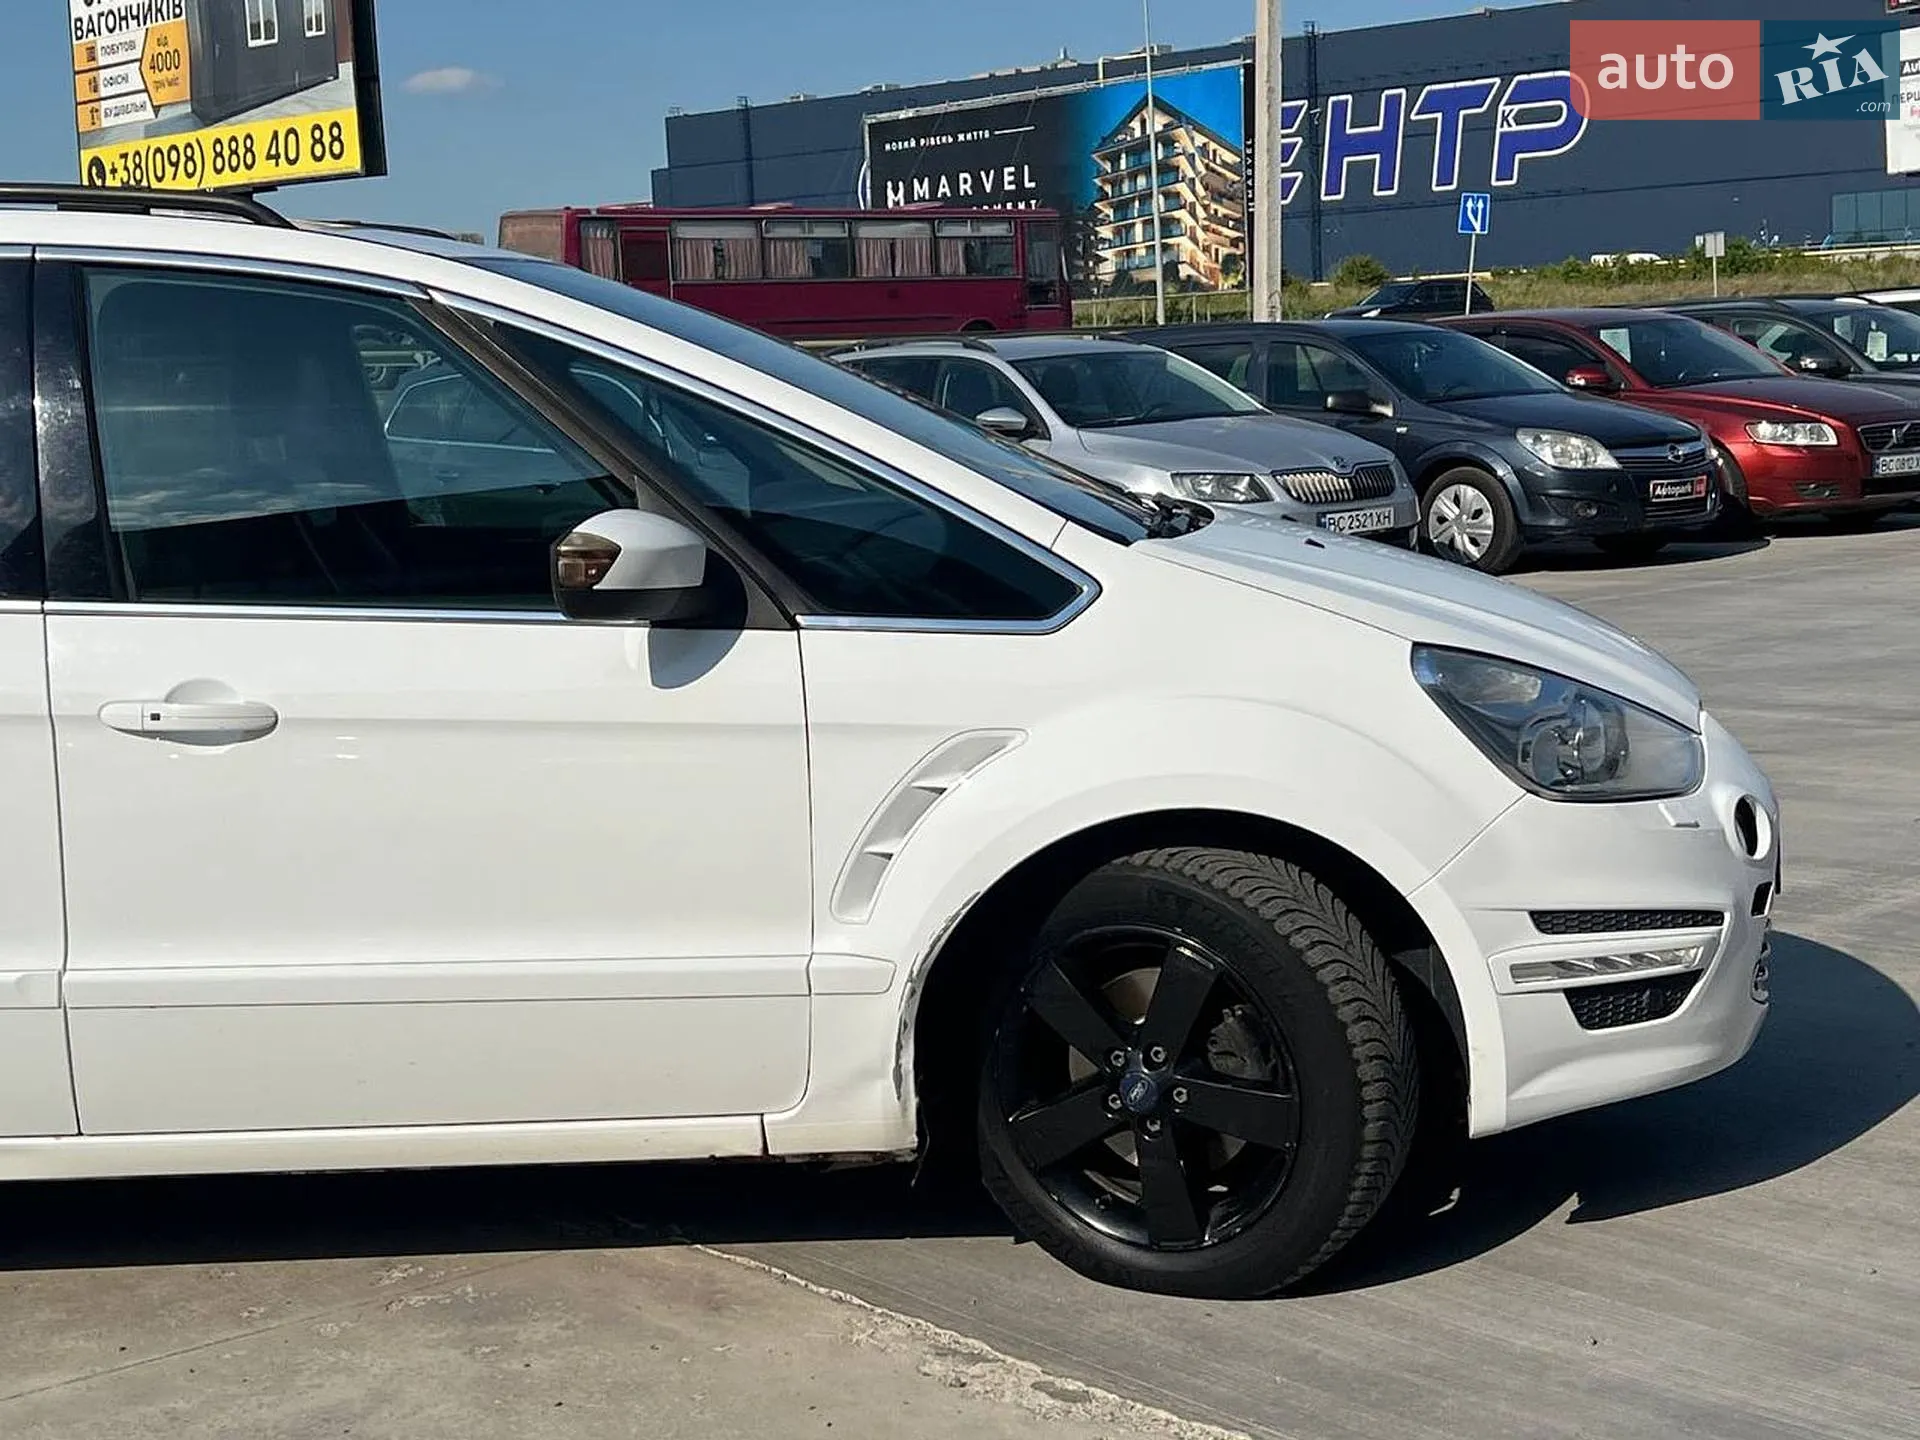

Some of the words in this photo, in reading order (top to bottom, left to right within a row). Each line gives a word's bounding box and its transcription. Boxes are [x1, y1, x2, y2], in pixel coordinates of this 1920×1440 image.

[74, 0, 183, 41] ВАГОНЧИКІВ
[149, 48, 181, 75] 4000
[108, 138, 205, 188] +38(098)
[212, 133, 256, 175] 888
[265, 126, 301, 168] 40
[310, 121, 345, 162] 88
[913, 164, 1036, 201] MARVEL
